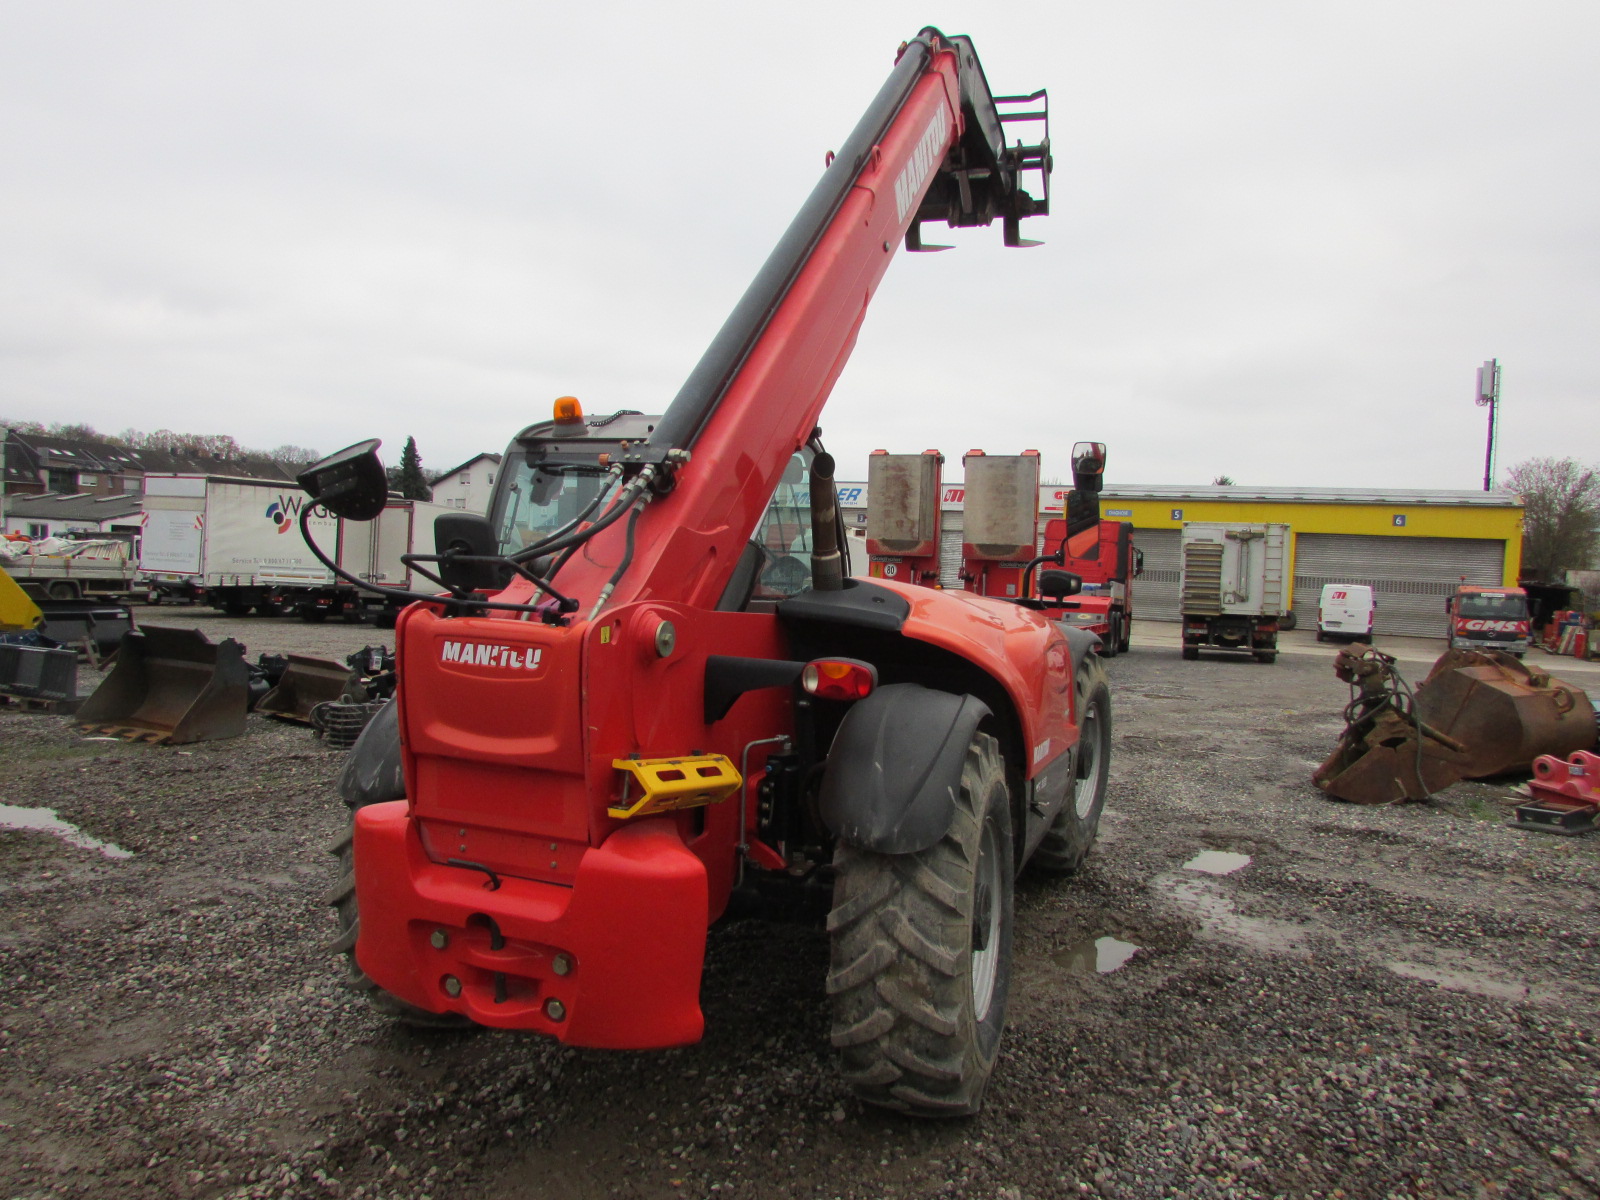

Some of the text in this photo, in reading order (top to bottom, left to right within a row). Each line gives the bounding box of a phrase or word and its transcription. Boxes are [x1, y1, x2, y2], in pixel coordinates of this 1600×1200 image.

[894, 99, 946, 225] MANITOU
[886, 565, 895, 575] 80
[1465, 619, 1519, 632] GMS
